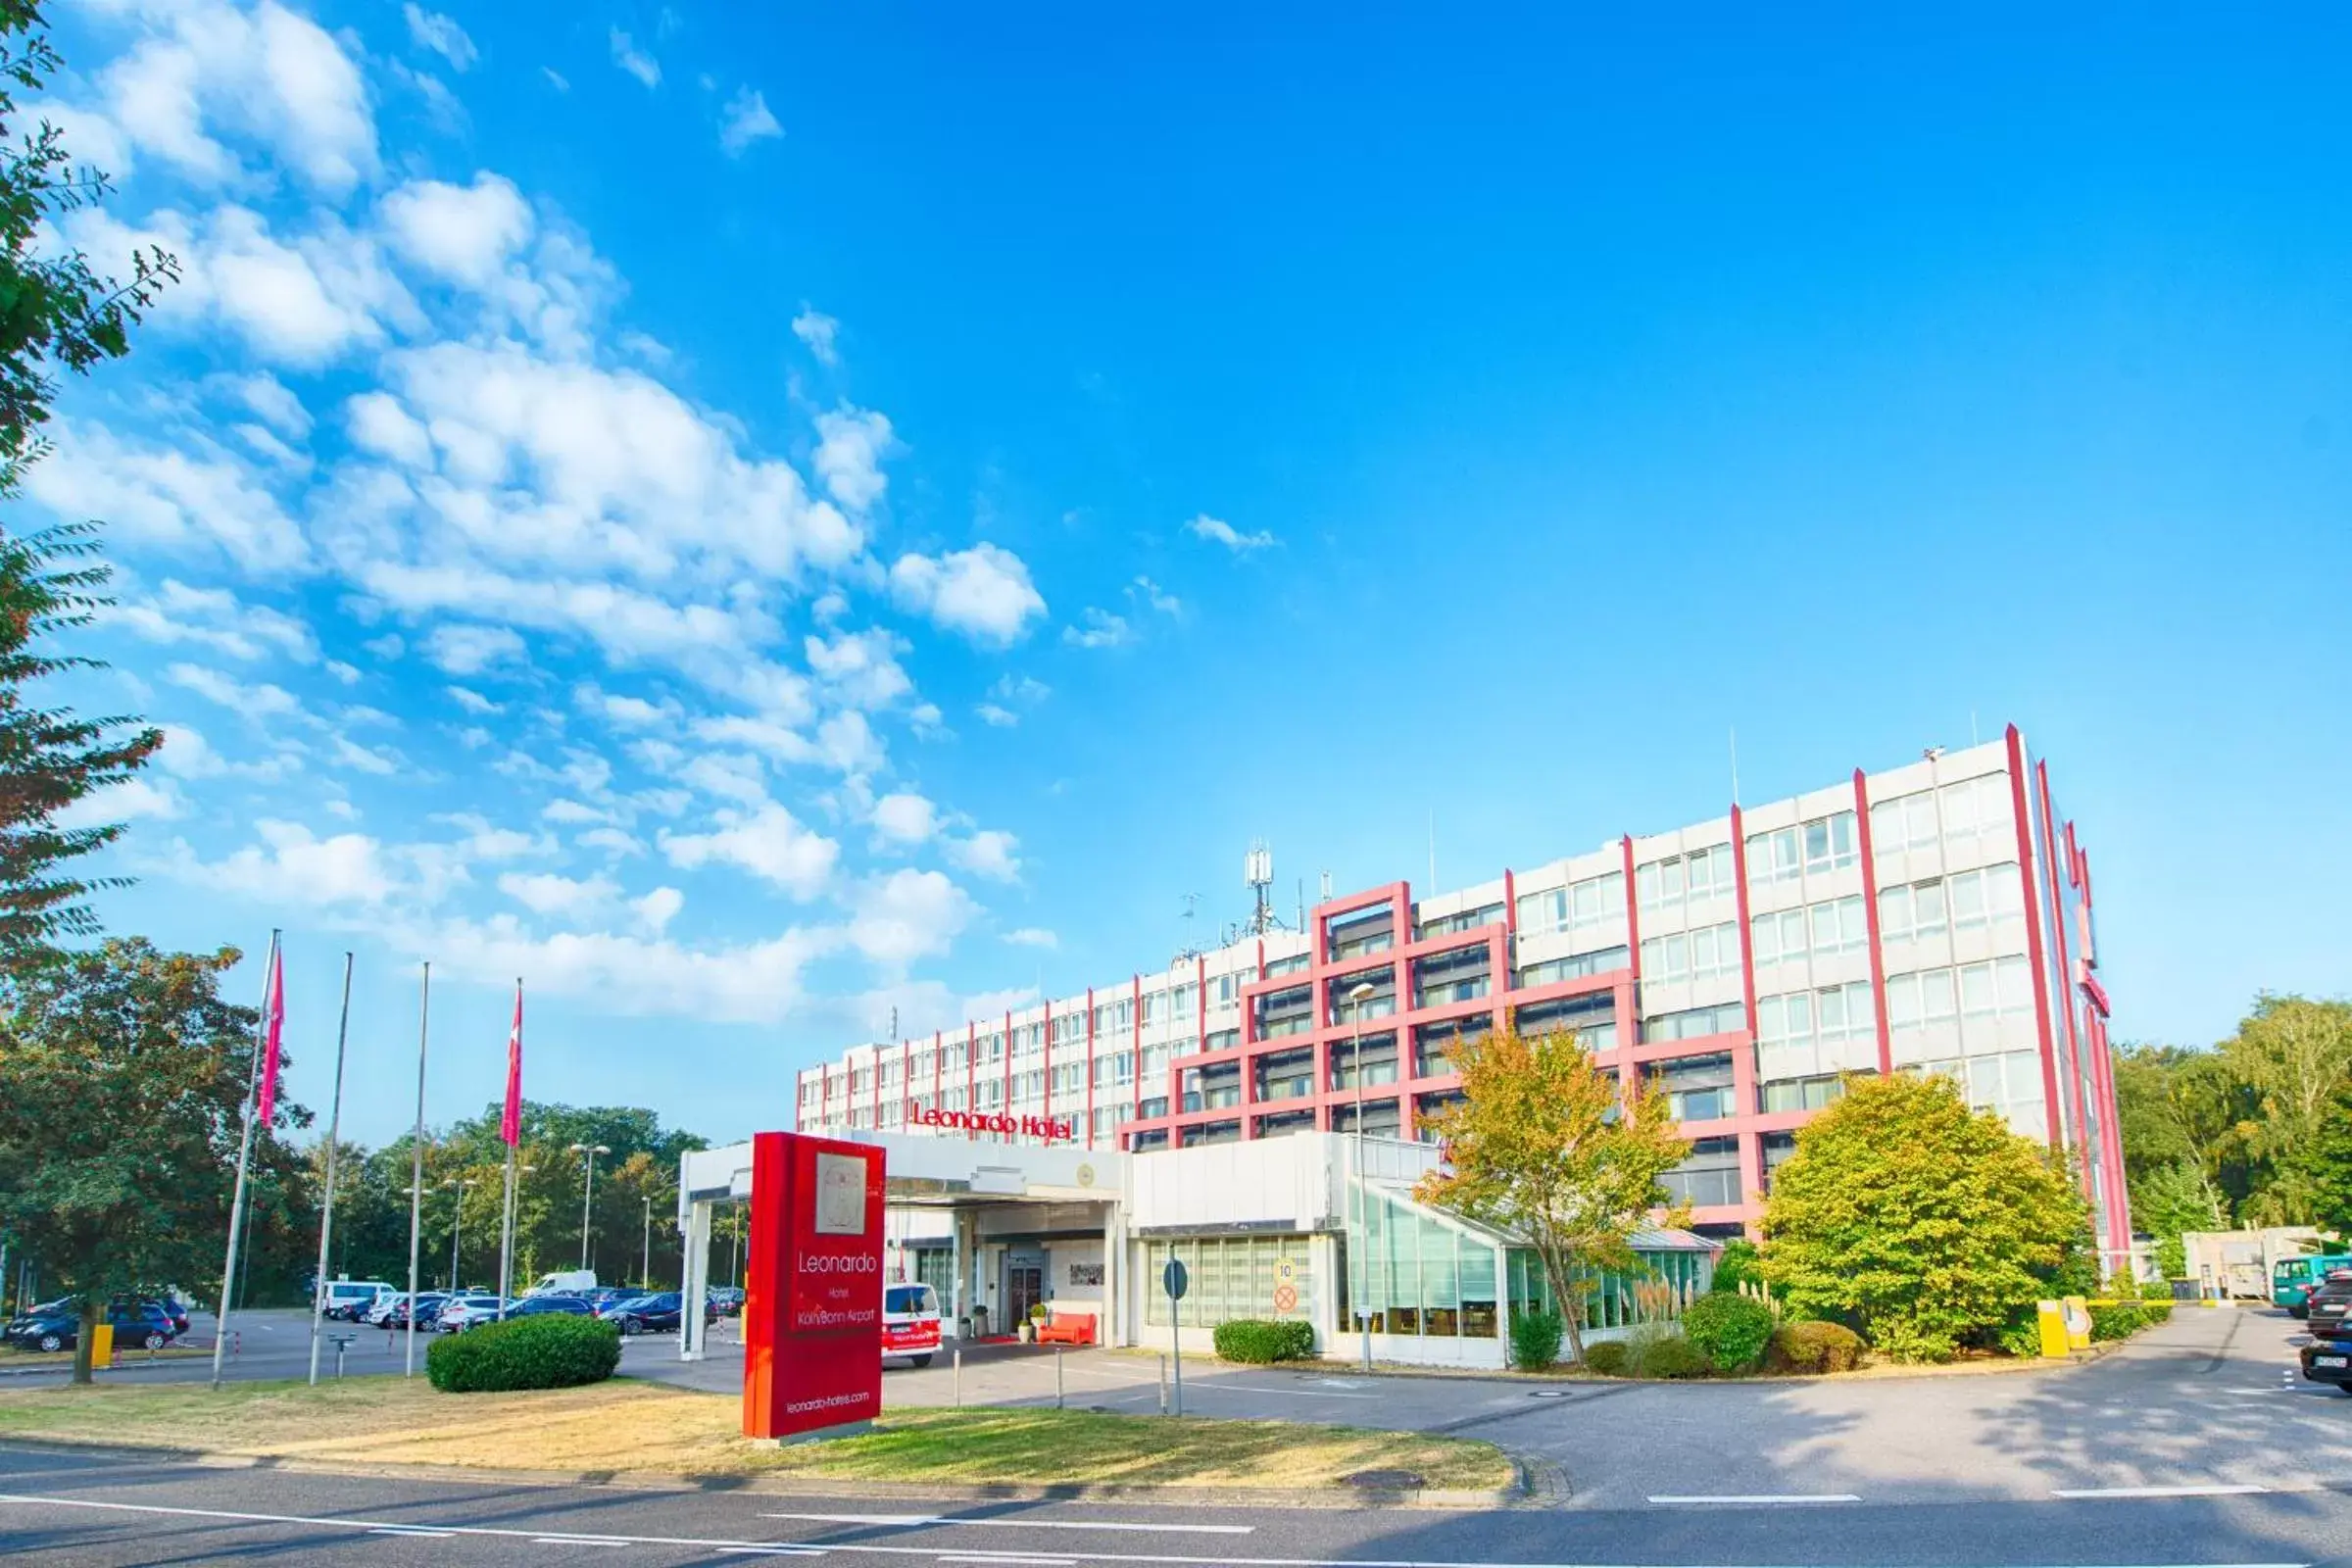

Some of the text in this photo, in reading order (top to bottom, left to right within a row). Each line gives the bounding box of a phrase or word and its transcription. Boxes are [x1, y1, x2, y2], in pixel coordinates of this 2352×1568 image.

[912, 1102, 1071, 1140] Leonardo Hotel
[799, 1250, 877, 1273] Leonardo
[828, 1287, 850, 1298] Hotel
[847, 1308, 874, 1323] Airport
